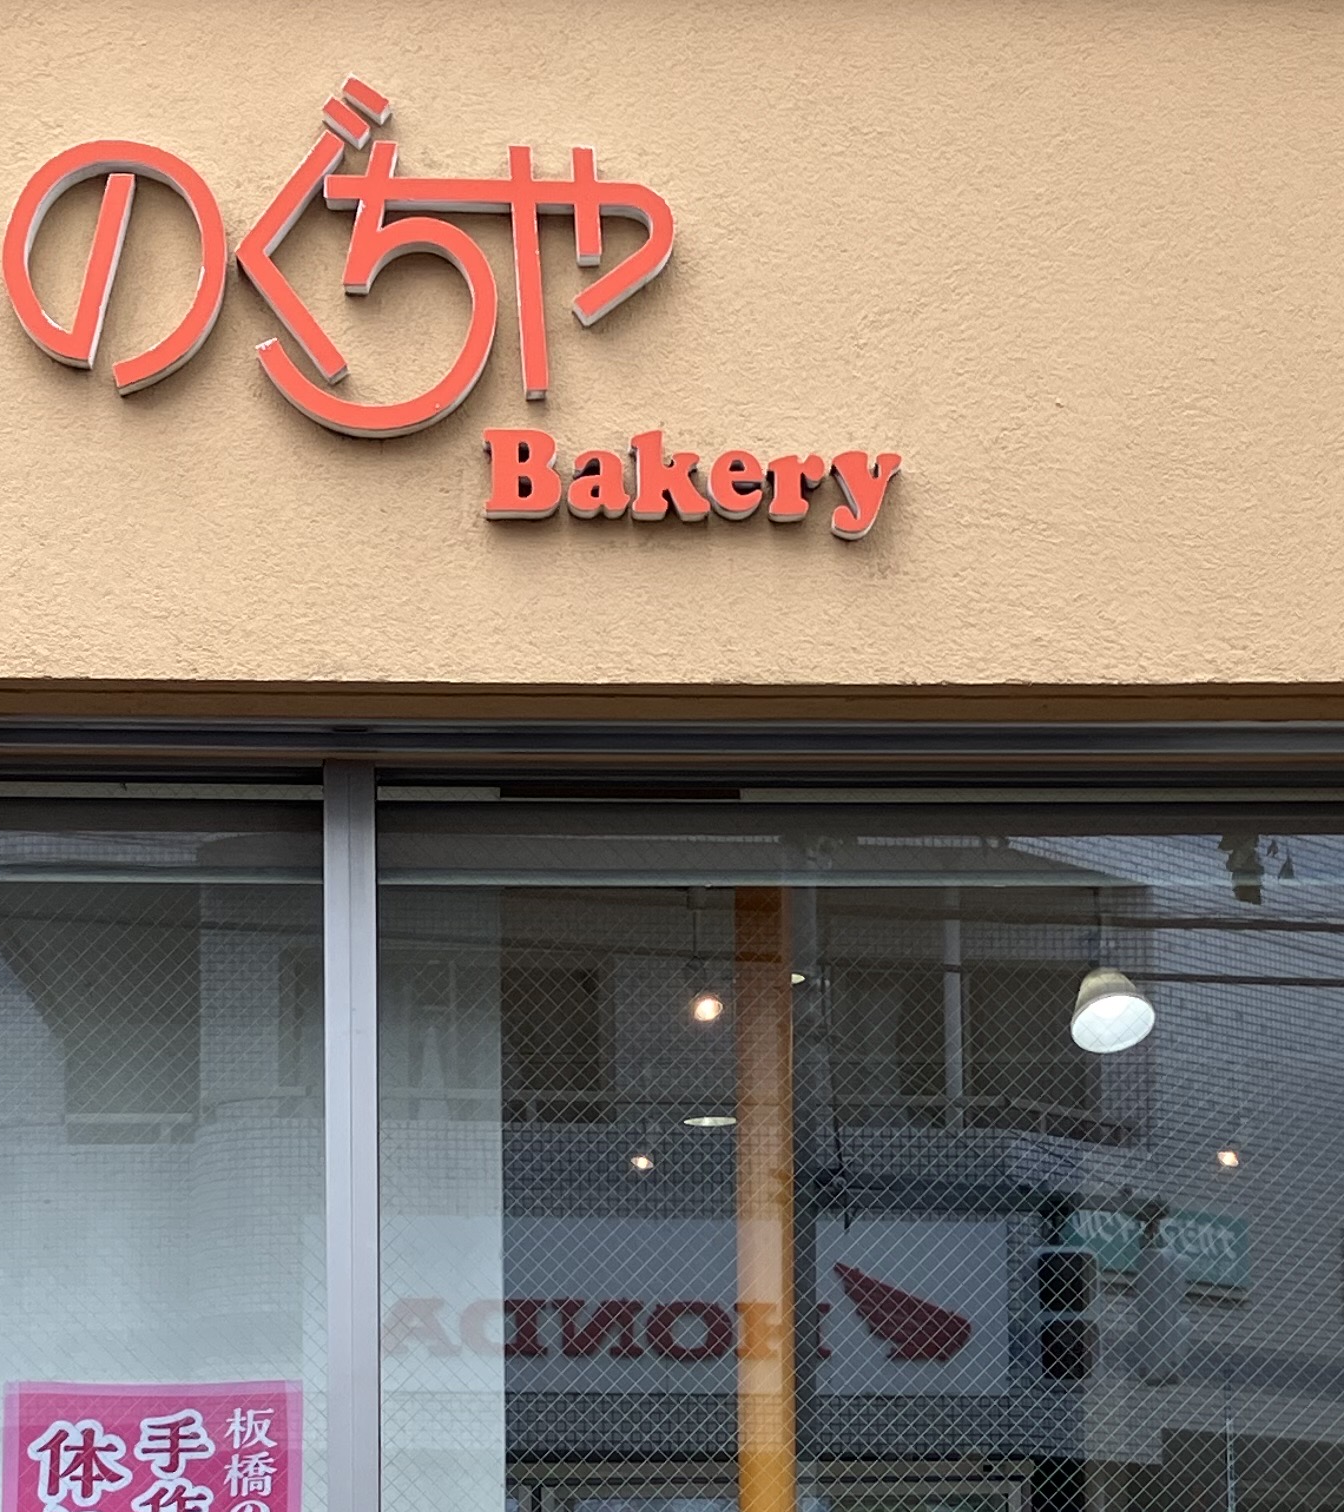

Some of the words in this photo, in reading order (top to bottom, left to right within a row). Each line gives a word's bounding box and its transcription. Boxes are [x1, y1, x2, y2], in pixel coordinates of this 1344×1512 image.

[3, 74, 674, 438] のぐちや
[483, 428, 901, 540] Bakery
